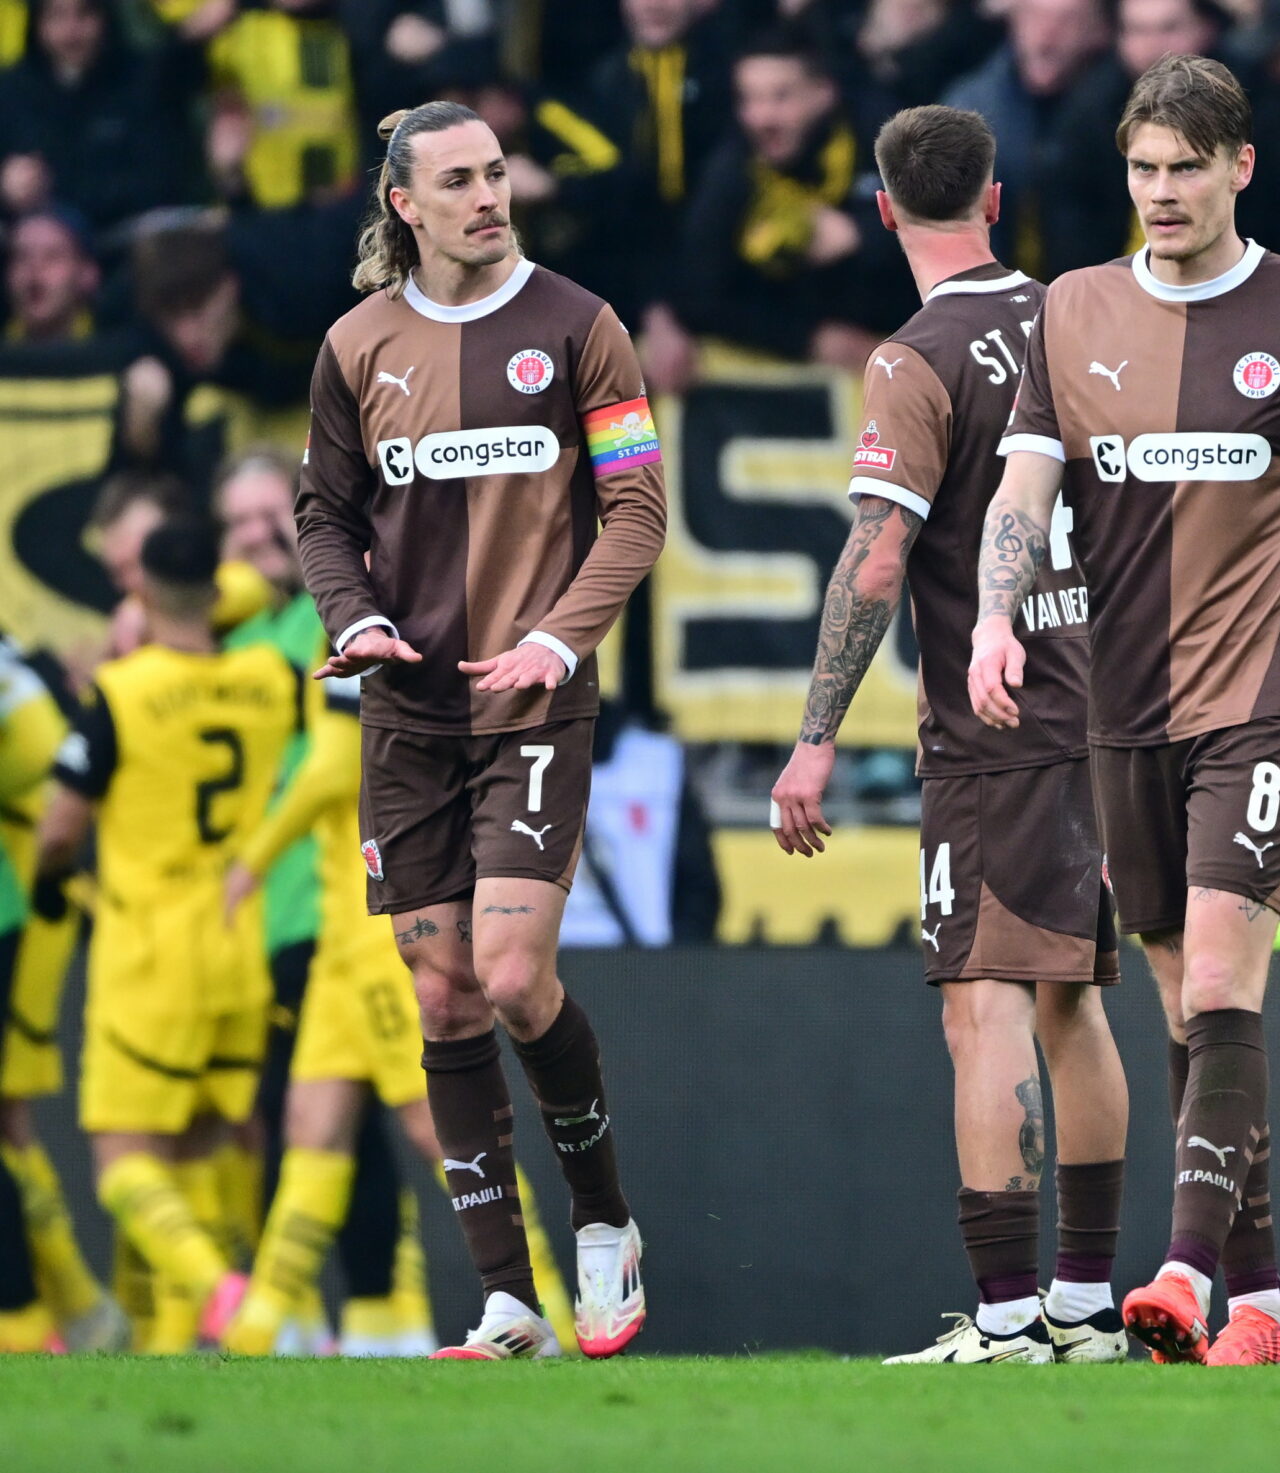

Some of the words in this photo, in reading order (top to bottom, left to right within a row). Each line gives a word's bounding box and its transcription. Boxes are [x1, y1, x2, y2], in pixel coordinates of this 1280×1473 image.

[531, 350, 552, 370] PAULI
[1260, 354, 1280, 376] PAULI
[521, 384, 541, 392] 1910
[1246, 389, 1266, 397] 1910
[431, 437, 545, 466] congstar
[617, 448, 633, 459] ST.
[1143, 444, 1257, 471] congstar
[1021, 591, 1062, 632] VAN
[195, 724, 244, 844] 2
[520, 745, 554, 812] 7
[1178, 1169, 1235, 1193] ST.PAULI
